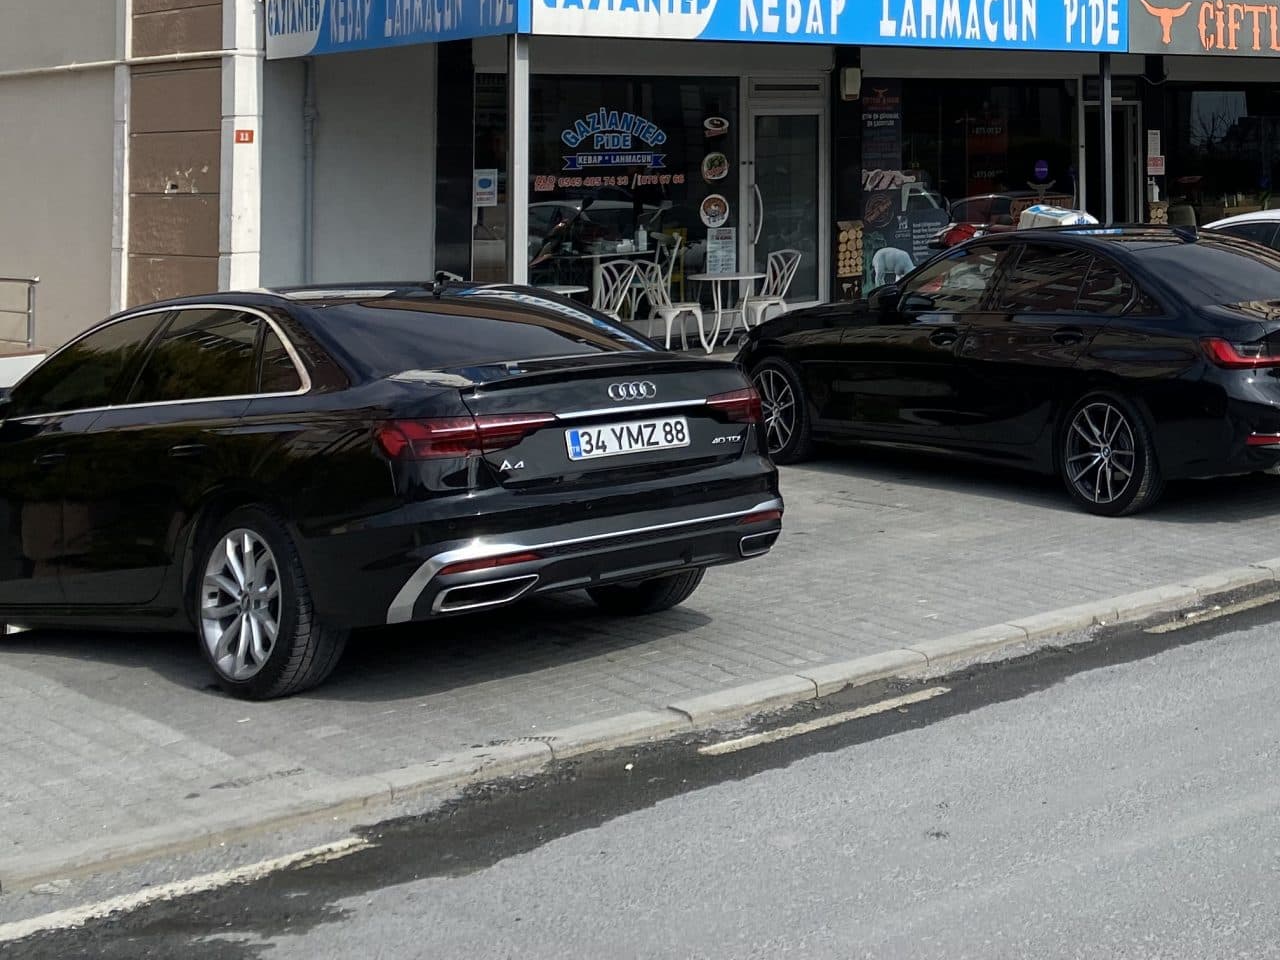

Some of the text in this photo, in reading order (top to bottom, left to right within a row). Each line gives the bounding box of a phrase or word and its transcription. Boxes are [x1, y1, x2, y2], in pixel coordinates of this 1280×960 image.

[560, 106, 667, 148] GAZİANTEP
[578, 153, 651, 165] KEBAP LAHMACUN
[580, 420, 686, 455] 34 YMZ 88
[500, 459, 525, 472] A4
